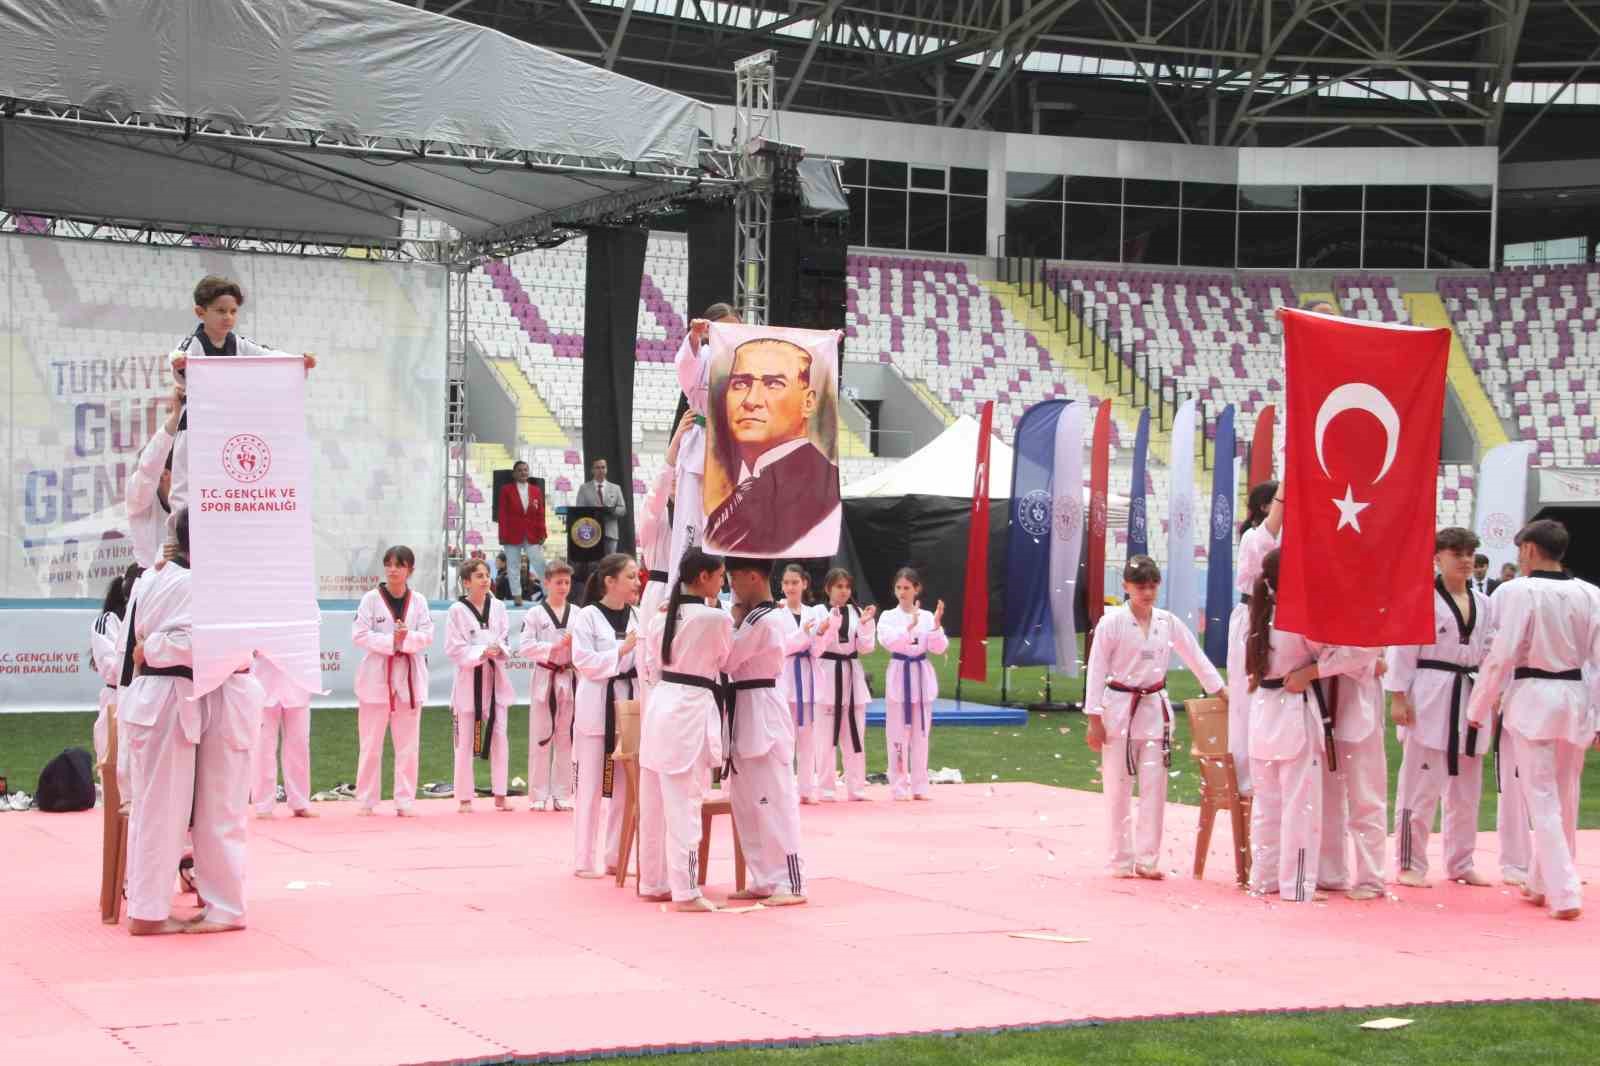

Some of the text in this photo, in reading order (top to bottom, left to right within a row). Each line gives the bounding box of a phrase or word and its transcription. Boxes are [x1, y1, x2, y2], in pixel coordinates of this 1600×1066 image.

[25, 462, 127, 525] GEN
[200, 486, 296, 501] T.C. GENÇLİK VE
[201, 500, 297, 512] SPOR BAKANLIĞI
[16, 650, 64, 664] GENÇLİK
[66, 653, 80, 662] VE
[23, 664, 79, 674] BAKANLIĞI
